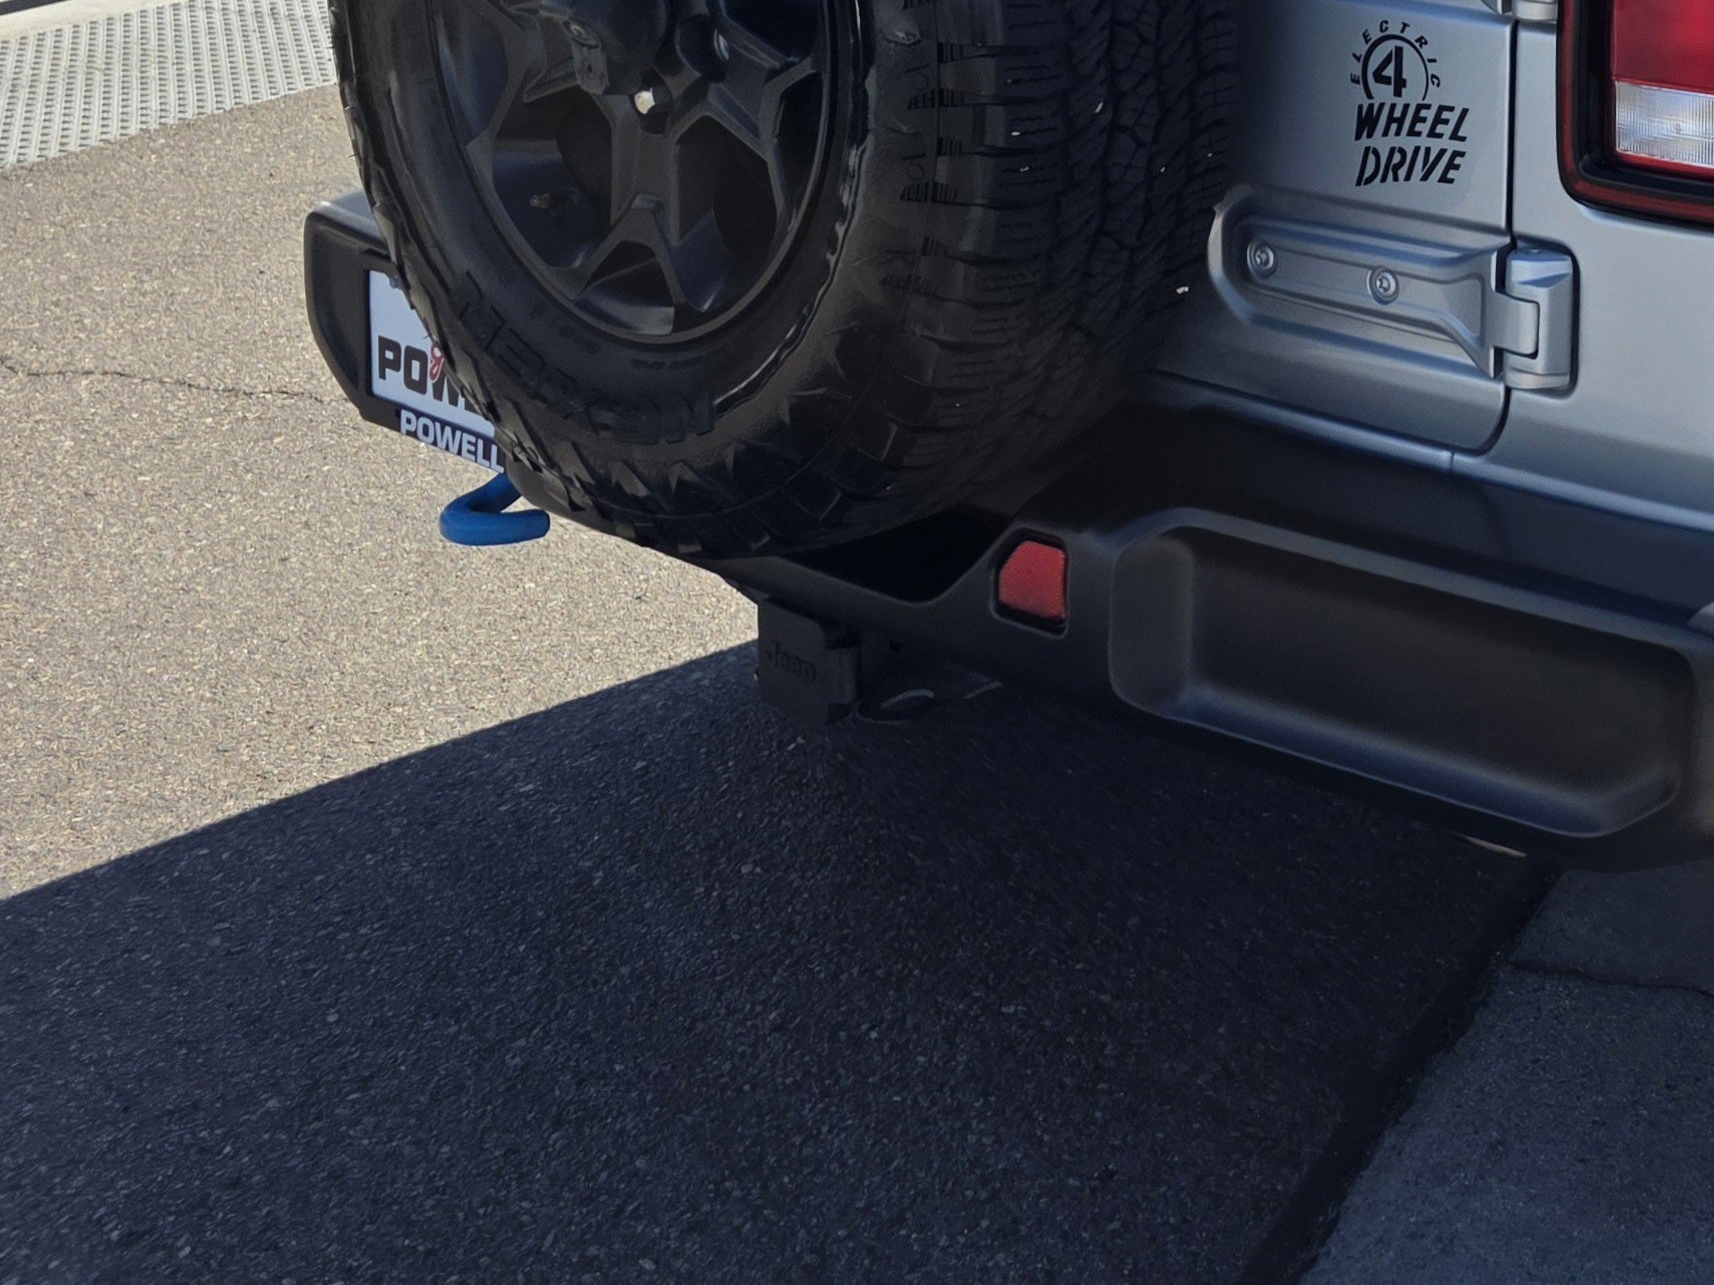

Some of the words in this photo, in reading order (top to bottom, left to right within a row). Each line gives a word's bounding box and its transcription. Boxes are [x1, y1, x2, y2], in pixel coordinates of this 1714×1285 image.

[1350, 20, 1441, 88] ELECTRIC
[1372, 46, 1407, 98] 4
[1354, 102, 1470, 143] WHEEL
[1355, 145, 1467, 187] DRIVE
[400, 409, 505, 473] POWELL
